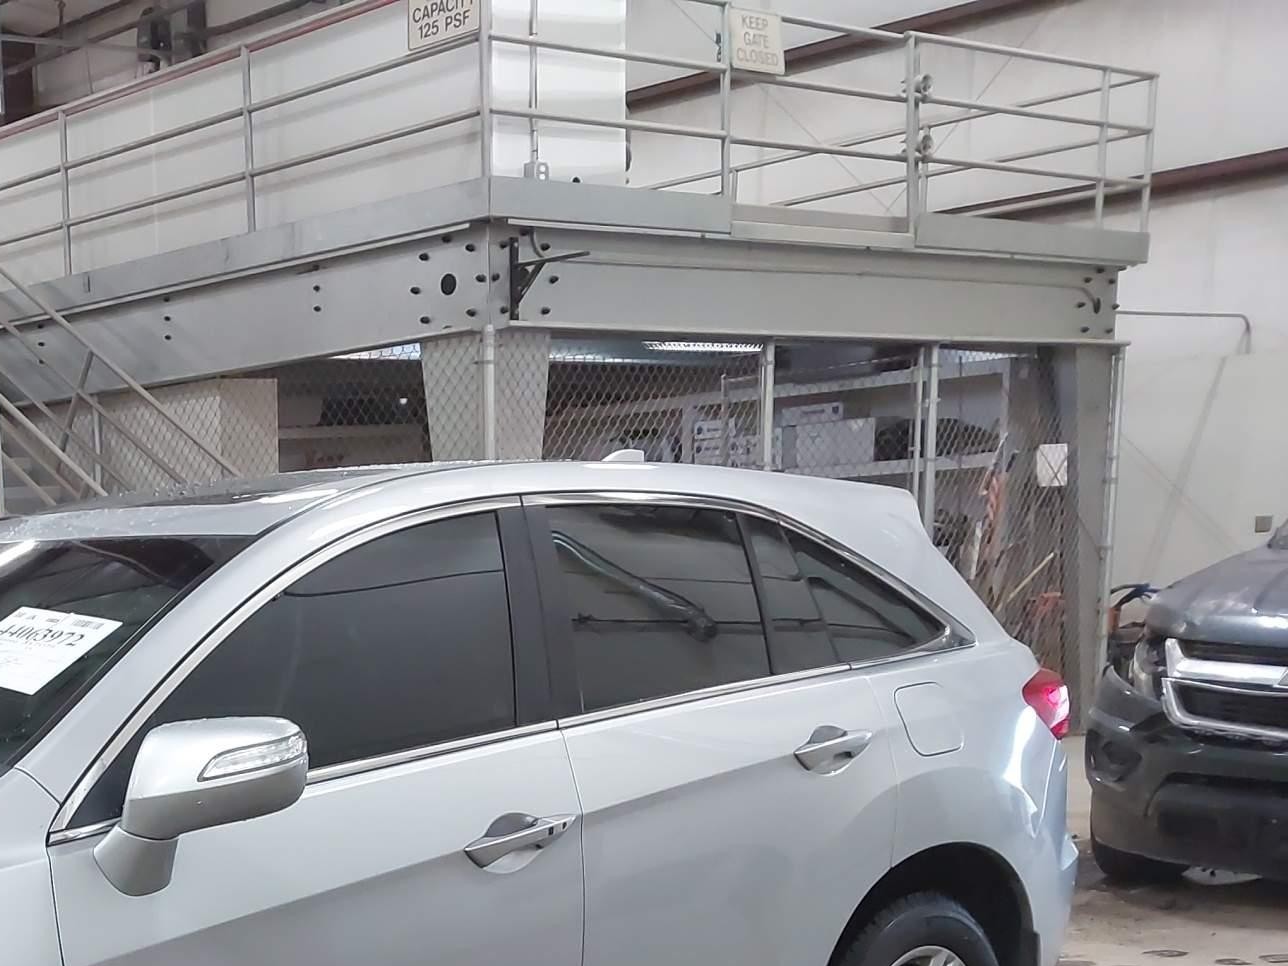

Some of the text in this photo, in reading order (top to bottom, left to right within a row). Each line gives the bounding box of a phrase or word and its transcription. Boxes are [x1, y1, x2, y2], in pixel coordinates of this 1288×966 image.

[418, 9, 470, 40] 125 PSF
[742, 14, 768, 30] KEEP
[744, 32, 769, 48] GATE
[737, 47, 778, 66] CLOSED
[0, 624, 86, 647] 44063972
